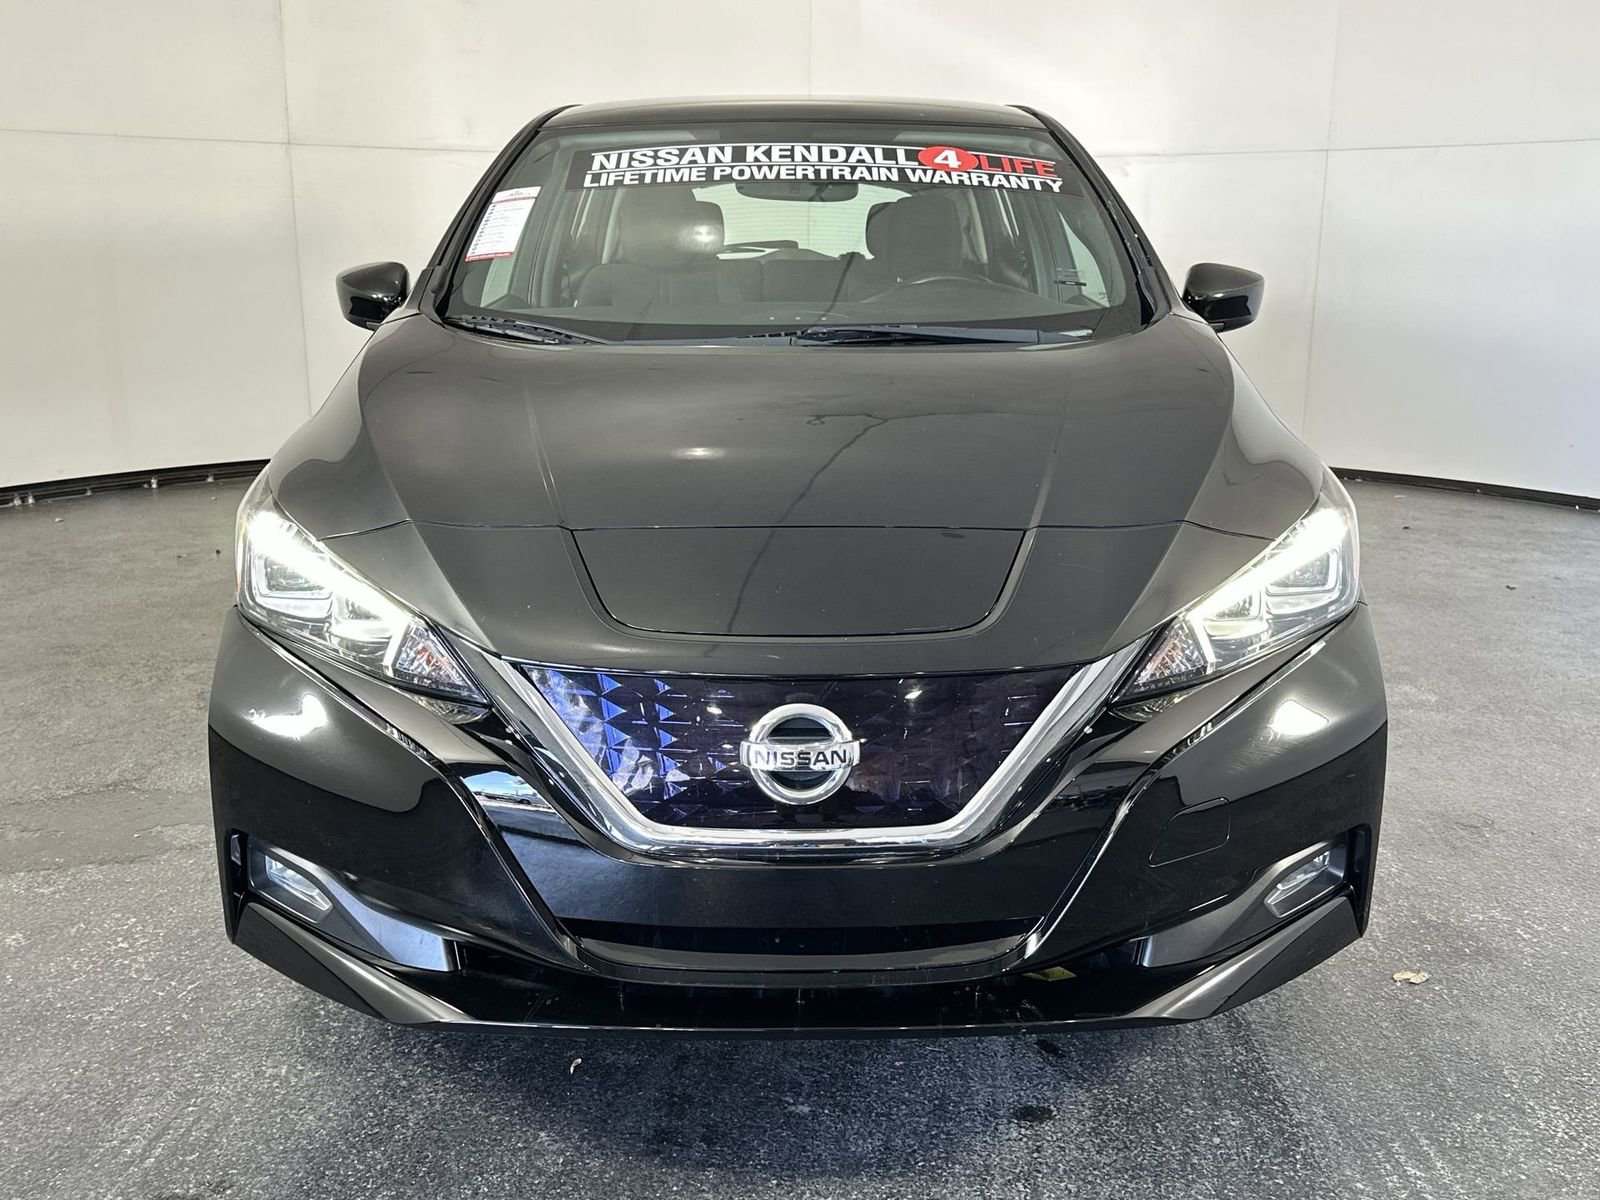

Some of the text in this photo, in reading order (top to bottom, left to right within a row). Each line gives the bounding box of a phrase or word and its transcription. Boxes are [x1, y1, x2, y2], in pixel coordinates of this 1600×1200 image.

[591, 145, 1058, 178] NISSAN KENDALL 4 LIFE
[583, 165, 1064, 193] LIFETIME POWERTRAIN WARRANTY
[754, 749, 847, 766] NISSAN
